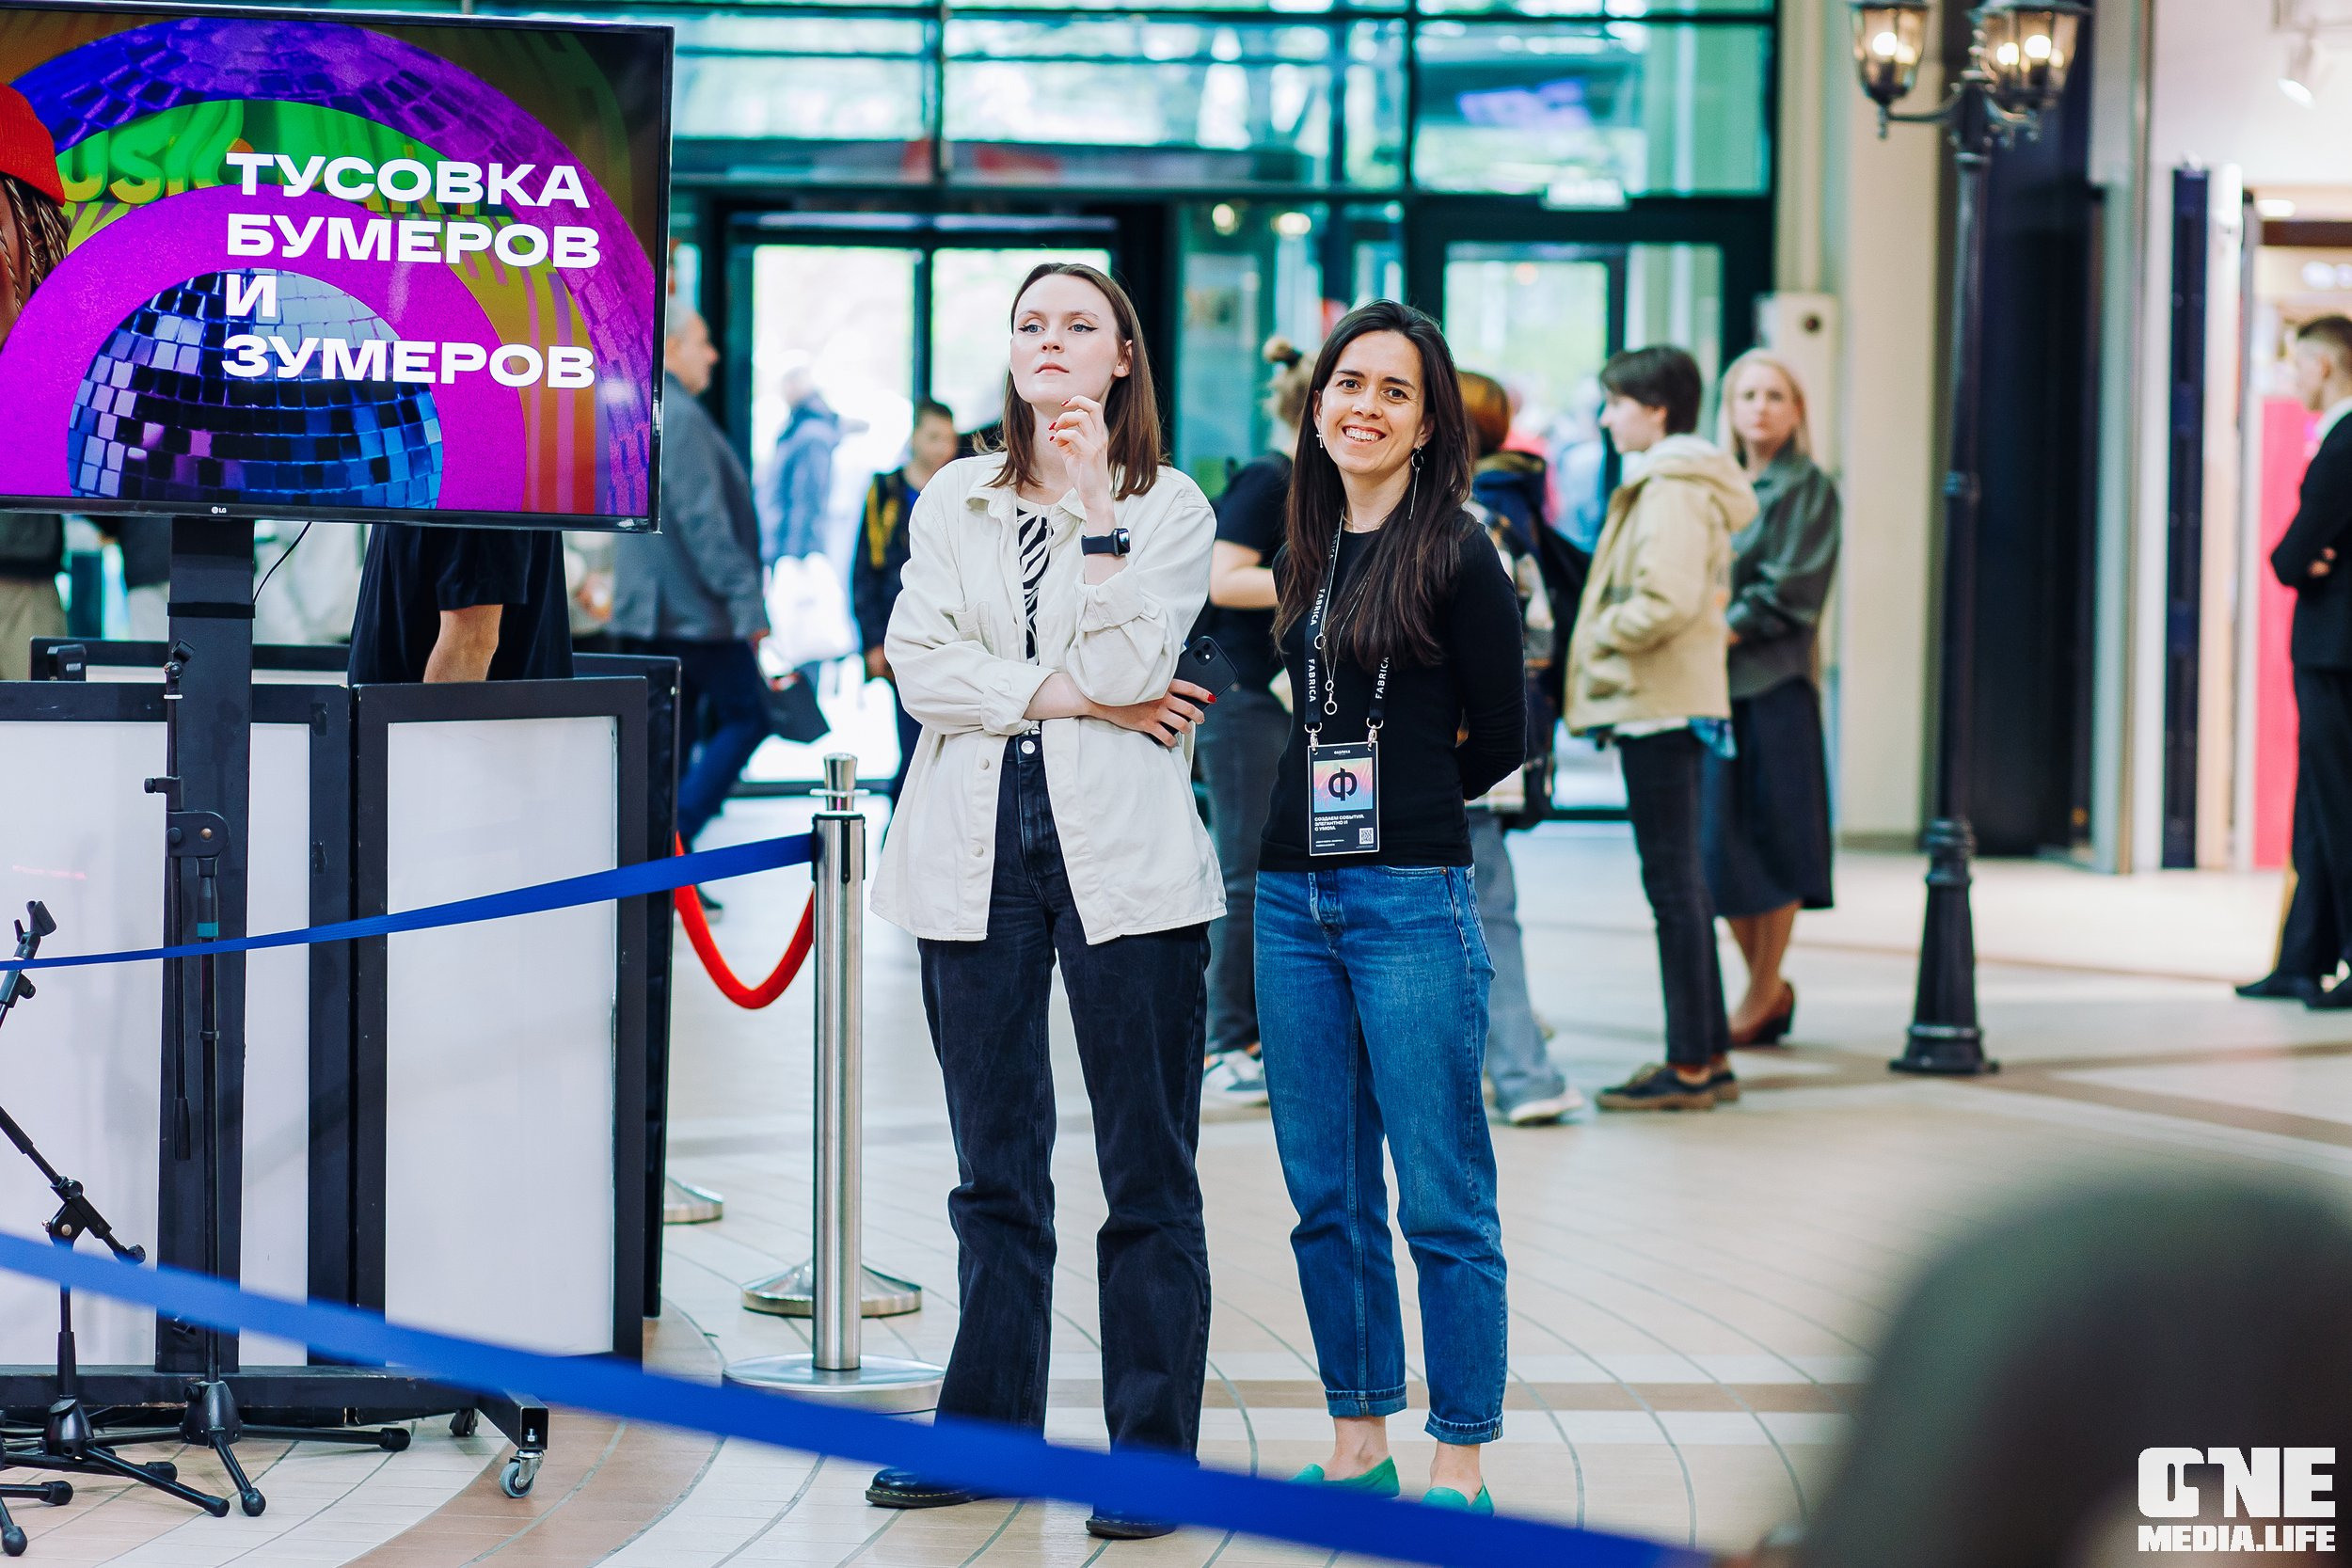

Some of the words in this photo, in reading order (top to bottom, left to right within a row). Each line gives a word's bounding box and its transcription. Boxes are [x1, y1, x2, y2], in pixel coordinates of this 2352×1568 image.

[226, 152, 591, 209] ТУСОВКА
[227, 214, 601, 269] БУМЕРОВ
[226, 274, 277, 318] И
[221, 334, 596, 388] ЗУМЕРОВ
[1310, 588, 1326, 626] FABRICA
[1308, 658, 1316, 702] FABRICA
[1375, 657, 1390, 700] FABRICA
